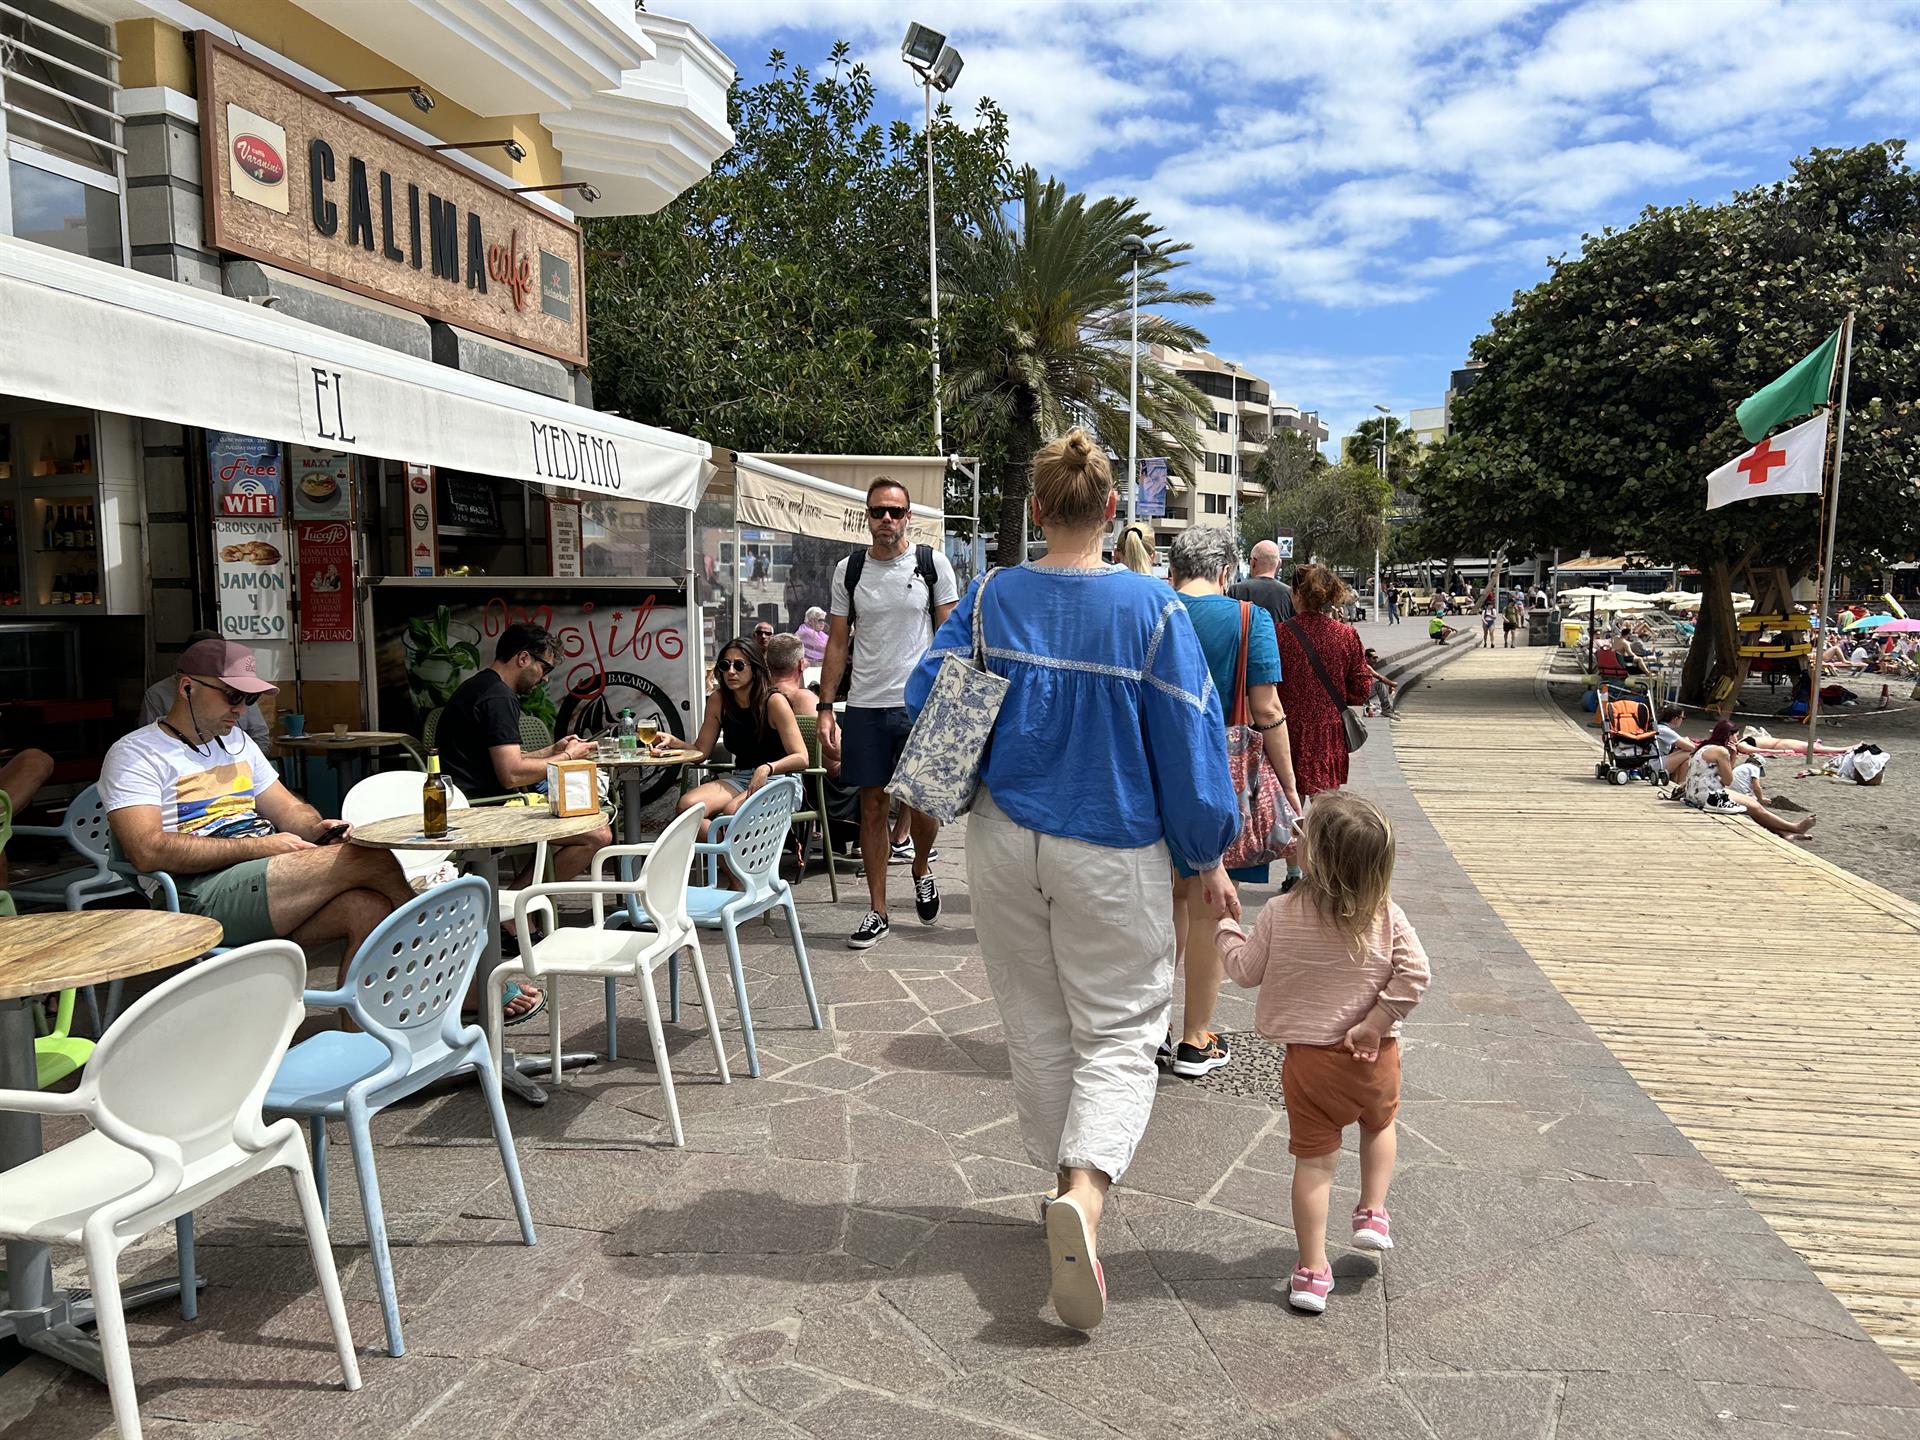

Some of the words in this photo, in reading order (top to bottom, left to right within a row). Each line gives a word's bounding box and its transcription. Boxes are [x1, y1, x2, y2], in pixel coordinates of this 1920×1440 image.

[237, 140, 283, 173] Varanini
[310, 139, 487, 294] CALIMA
[311, 367, 356, 444] EL
[530, 420, 621, 490] MEDANO
[219, 457, 277, 482] Free
[303, 459, 331, 468] MAXY
[224, 494, 276, 513] WiFi
[217, 521, 278, 535] CROISSANT
[220, 570, 285, 590] JAMÓN
[224, 615, 284, 636] QUESO
[313, 629, 352, 641] ITALIANO
[608, 673, 655, 694] BACARDI
